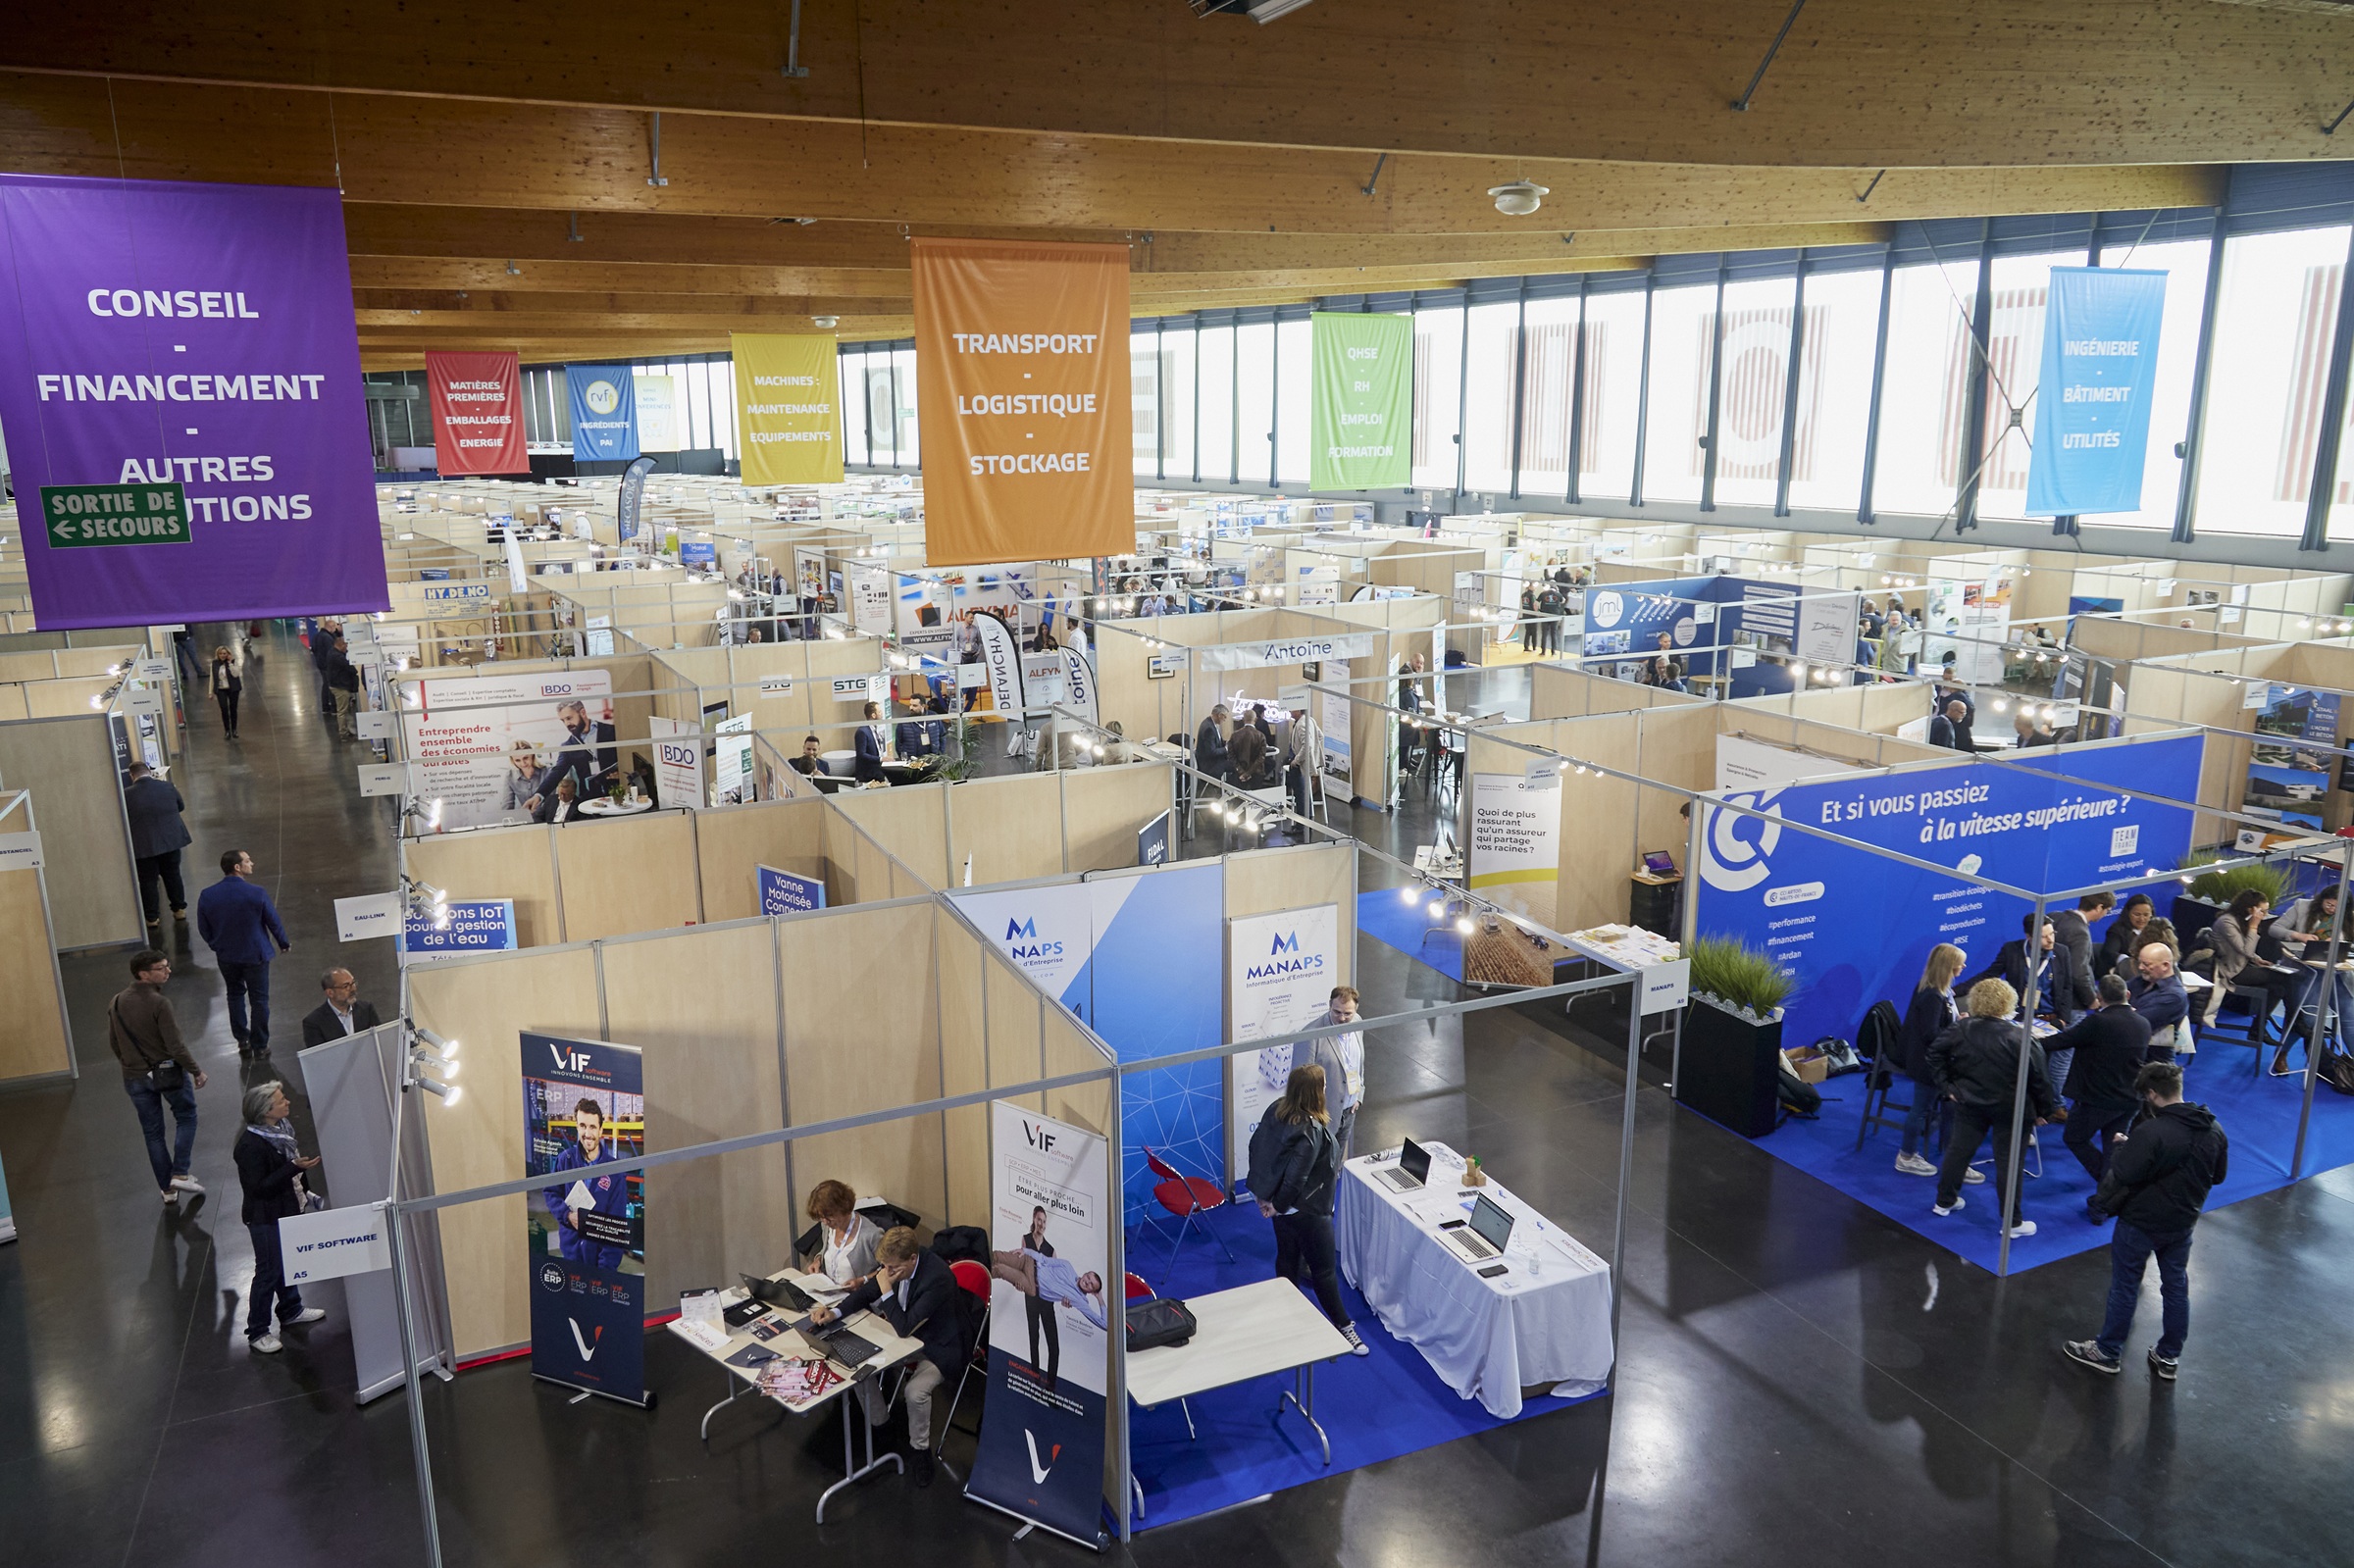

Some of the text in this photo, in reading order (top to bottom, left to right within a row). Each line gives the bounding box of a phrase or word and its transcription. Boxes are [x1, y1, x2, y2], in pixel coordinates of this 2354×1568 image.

[87, 288, 259, 319] CONSEIL
[953, 333, 1097, 355] TRANSPORT
[2065, 337, 2139, 357] INGÉNIERIE
[1347, 347, 1378, 362] QHSE
[37, 373, 325, 402] FINANCEMENT
[449, 380, 501, 390] MATIÈRES
[754, 376, 813, 386] MACHINES
[1355, 380, 1370, 392] RH
[447, 391, 506, 402] PREMIÈRES
[2063, 383, 2131, 403] BÂTIMENT
[746, 404, 831, 415] MAINTENANCE
[958, 394, 1097, 418] LOGISTIQUE
[445, 416, 512, 426] EMBALLAGES
[580, 421, 630, 430] INGRÉDIENTS
[1341, 413, 1383, 426] EMPLOI
[460, 438, 504, 448] ENERGIE
[749, 431, 832, 444] EQUIPEMENTS
[2063, 429, 2120, 449] UTILITÉS
[1328, 445, 1394, 458] FORMATION
[119, 455, 275, 484] AUTRES
[970, 452, 1090, 476] STOCKAGE
[51, 491, 177, 515] SORTIE DE
[185, 493, 313, 524] TIONS
[625, 479, 638, 533] MECASOKA
[81, 515, 180, 538] SECOURS
[427, 586, 488, 598] HY.DE.NO
[1593, 596, 1621, 618] jml
[1264, 641, 1332, 660] Antoine
[1028, 667, 1061, 678] ALFYM
[834, 679, 867, 690] STG
[1068, 656, 1086, 705] toine
[544, 684, 572, 694] BDO
[419, 725, 491, 737] Entreprendre
[725, 721, 744, 733] STG
[420, 736, 473, 747] ensemble
[422, 744, 501, 757] des économies
[664, 744, 694, 765] BDO
[1821, 781, 1991, 824] Et si vous passiez
[1477, 808, 1500, 817] Quoi
[1516, 810, 1536, 819] plus
[1919, 794, 2131, 843] à la vitesse supérieure ?
[1477, 818, 1521, 827] rassurant
[1506, 828, 1547, 836] assureur
[2116, 829, 2137, 842] TEAM
[1494, 835, 1530, 846] partage
[1148, 839, 1165, 861] FIDAL
[1494, 844, 1528, 853] racines
[775, 875, 803, 893] Vanne
[768, 886, 812, 909] Motorisée
[1932, 889, 1967, 901] #transition
[480, 906, 503, 919] IoT
[1945, 902, 1983, 915] #biodéchets
[455, 919, 506, 933] gestion
[1768, 915, 1817, 931] #performance
[1939, 917, 1986, 932] #écoproduction
[423, 934, 444, 945] de
[1767, 932, 1815, 946] #financement
[1011, 941, 1063, 959] NAPS
[1778, 950, 1802, 961] #Ardan
[1247, 954, 1323, 980] MANAPS
[1781, 967, 1796, 977] #RH
[1246, 976, 1286, 988] Informatique
[1651, 983, 1674, 992] MANAPS
[549, 1043, 591, 1073] VIF
[551, 1070, 612, 1084] INNOVONS ENSEMBLE
[585, 1067, 611, 1078] software
[537, 1087, 562, 1102] ERP
[1023, 1119, 1056, 1152] VIF
[1034, 1183, 1049, 1193] PLUS
[1016, 1184, 1085, 1217] pour aller plus loin
[296, 1233, 378, 1253] VIF SOFTWARE
[293, 1270, 308, 1280] A5
[543, 1273, 562, 1285] ERP
[571, 1280, 588, 1290] ERP
[591, 1286, 608, 1295] ERP
[612, 1290, 630, 1300] ERP
